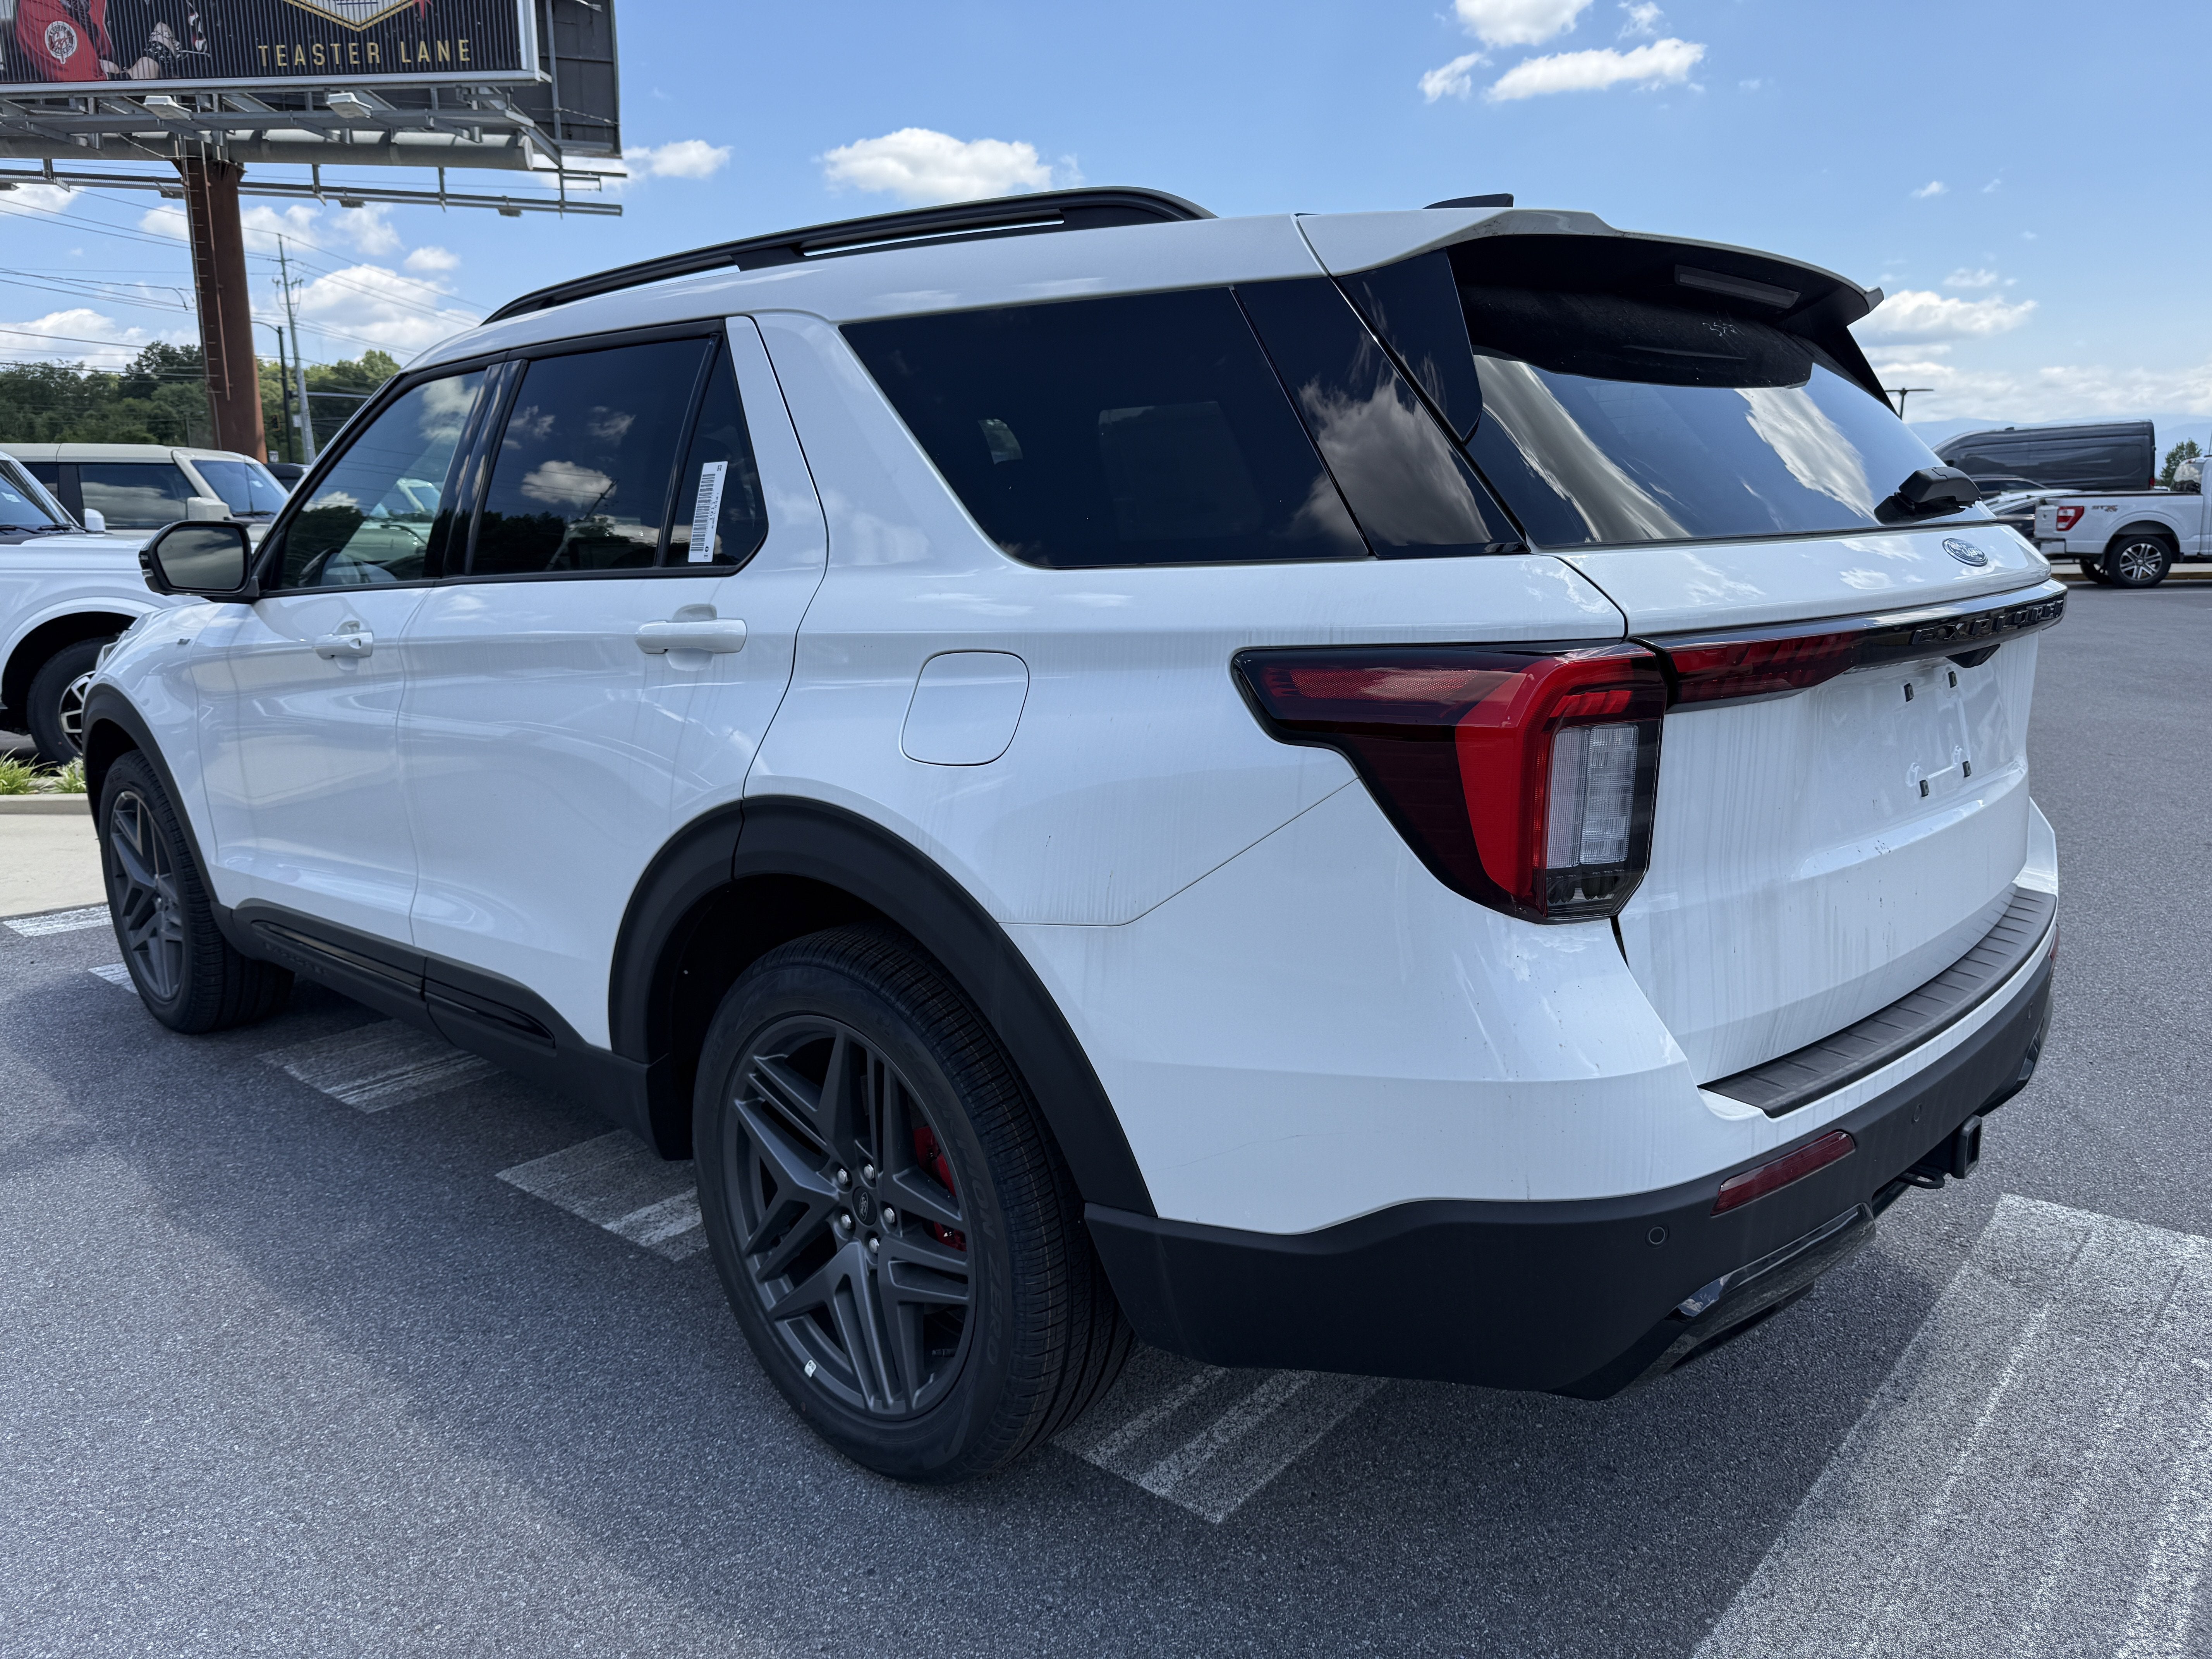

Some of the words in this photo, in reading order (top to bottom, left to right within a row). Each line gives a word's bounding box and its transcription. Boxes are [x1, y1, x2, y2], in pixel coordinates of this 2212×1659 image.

[258, 42, 380, 67] TEASTER
[400, 39, 471, 64] LANE
[1911, 600, 2064, 645] EXPLORER
